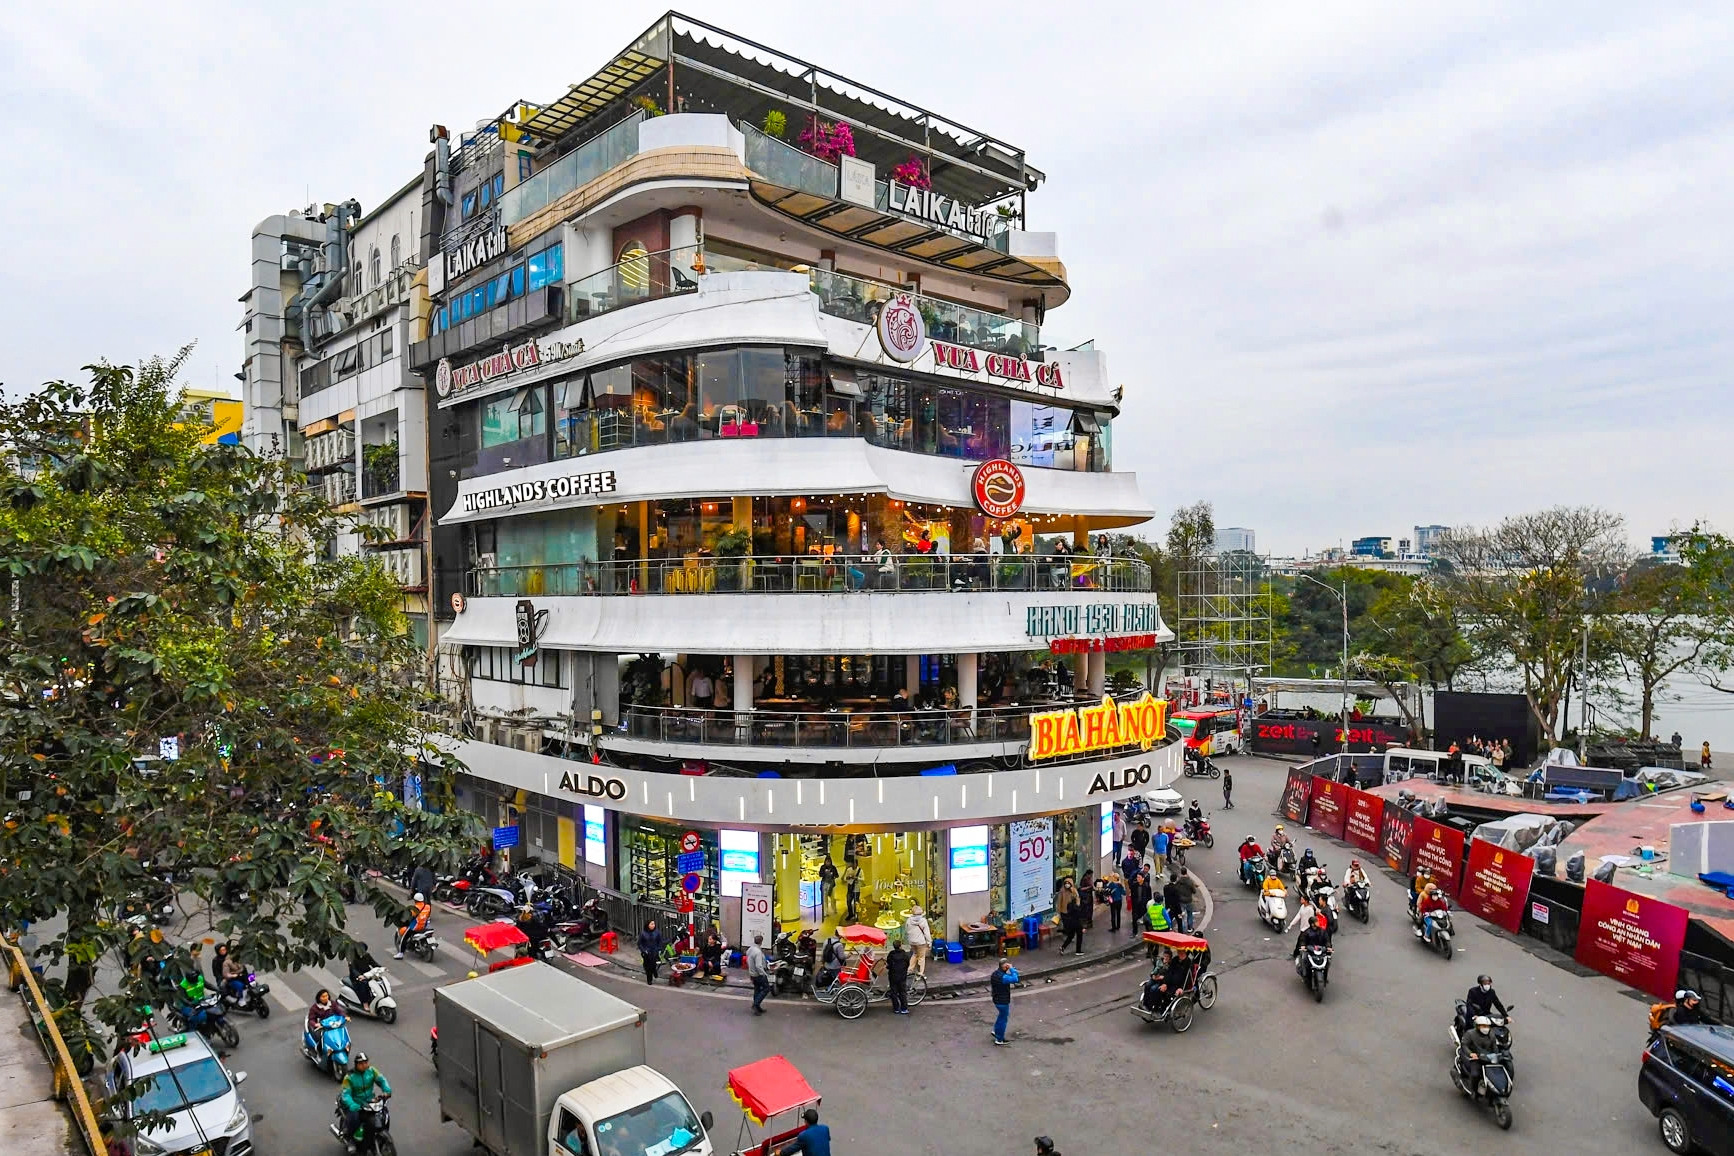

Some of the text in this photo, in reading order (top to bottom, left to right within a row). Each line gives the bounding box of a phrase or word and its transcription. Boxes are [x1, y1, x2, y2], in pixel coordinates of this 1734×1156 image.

[889, 179, 965, 232] LAIKA
[447, 225, 507, 280] LAIKA Café
[452, 362, 480, 389] VUA
[479, 344, 513, 380] CHẢ
[512, 337, 540, 370] CÁ
[931, 341, 1064, 389] VUA CHẢ CÁ
[463, 471, 615, 512] HIGHLANDS COFFEE
[978, 463, 1023, 515] HIGHLANDS COFFEE
[1027, 604, 1160, 636] HANOI 1930 BISTRO
[1031, 693, 1167, 760] BIA HÀ NỘI
[1258, 724, 1295, 739] zeit
[559, 770, 627, 800] ALDO
[1088, 763, 1152, 795] ALDO
[1018, 836, 1045, 863] 50
[746, 898, 768, 914] 50
[1598, 920, 1616, 933] CÔNG
[1616, 927, 1626, 936] AN
[1626, 930, 1645, 943] NHÂN
[1645, 938, 1661, 950] DÂN
[1610, 918, 1625, 929] VĨNH
[1626, 923, 1649, 938] QUANG
[1612, 933, 1625, 943] VIỆT
[1627, 939, 1642, 950] NAM
